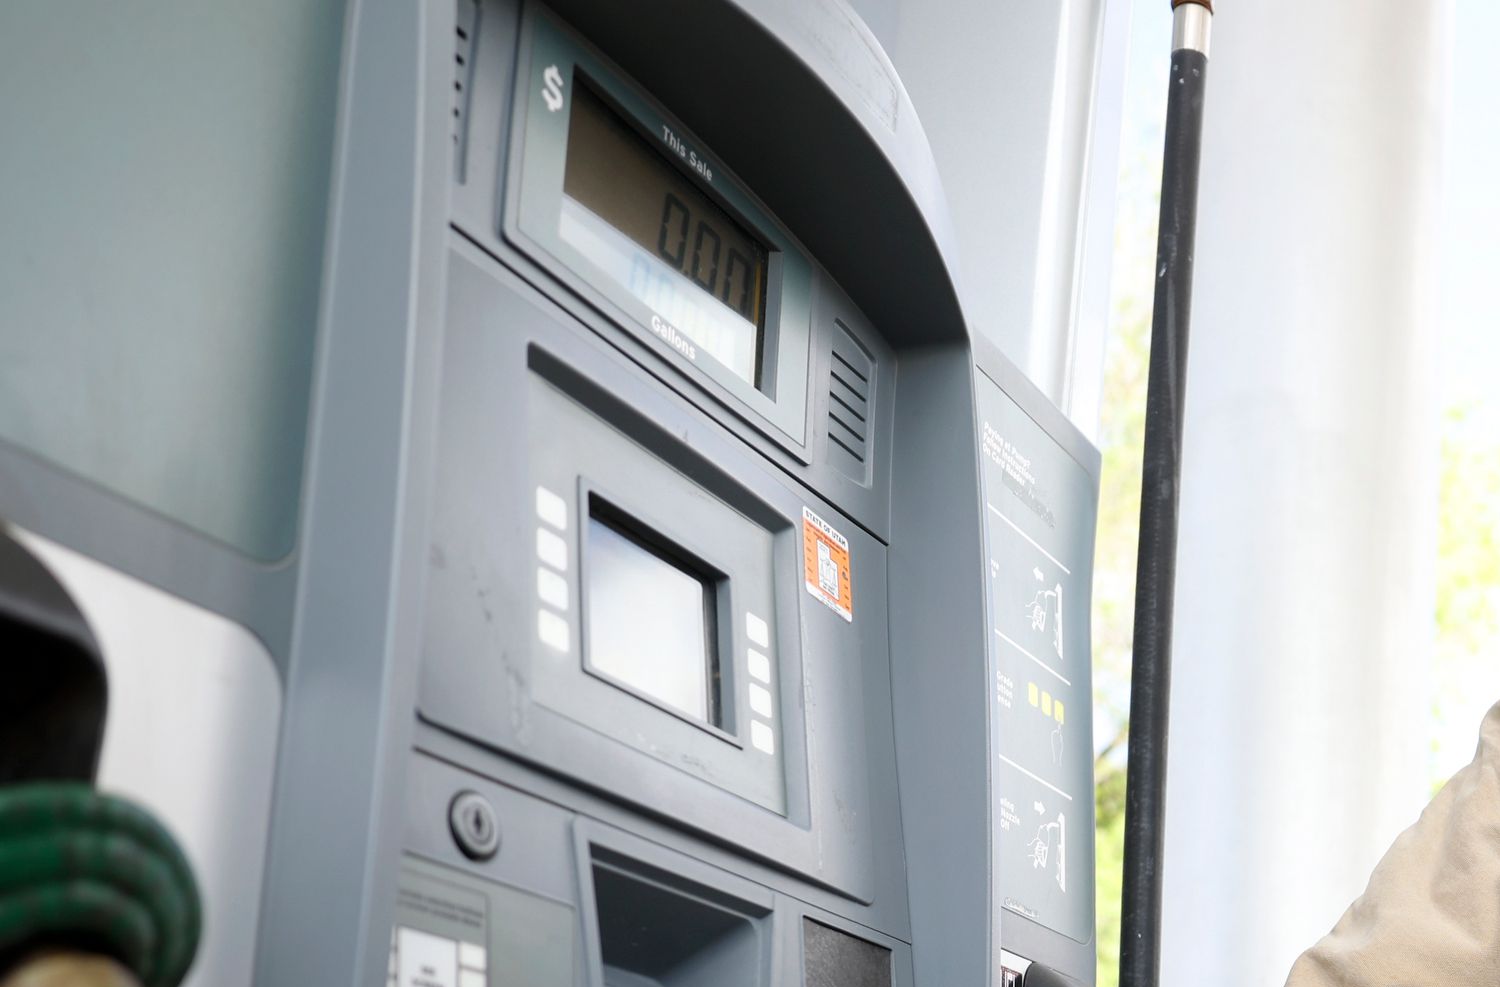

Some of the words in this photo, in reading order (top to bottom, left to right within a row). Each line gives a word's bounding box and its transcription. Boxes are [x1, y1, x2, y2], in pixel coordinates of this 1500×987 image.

[662, 125, 686, 157] This
[689, 151, 713, 182] Sale
[651, 314, 696, 360] Gallons
[984, 421, 1004, 447] Paying
[992, 451, 1005, 469] Card
[805, 510, 822, 528] STATE
[823, 524, 831, 535] OF
[831, 530, 846, 546] UTAH
